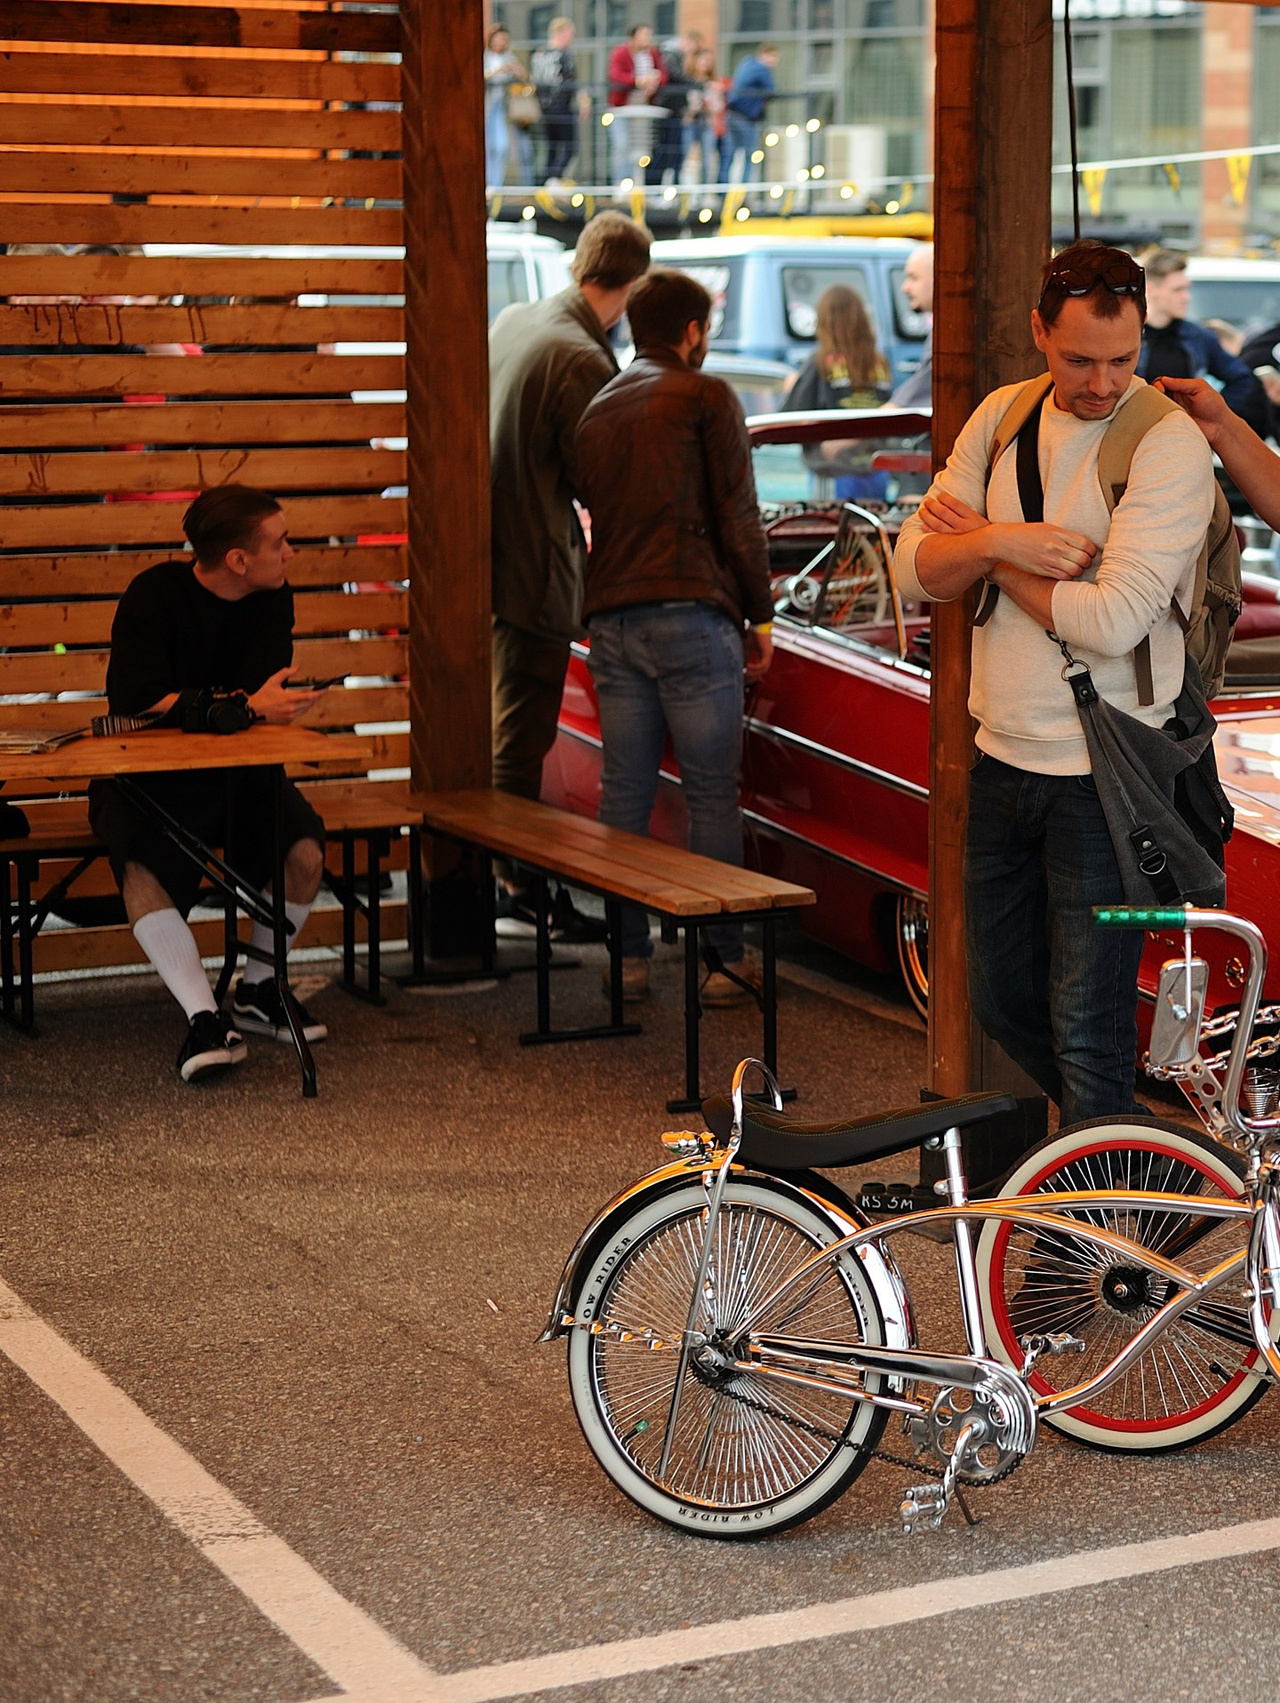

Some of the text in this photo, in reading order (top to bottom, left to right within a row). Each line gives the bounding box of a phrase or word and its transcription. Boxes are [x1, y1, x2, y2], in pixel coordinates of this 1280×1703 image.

[595, 1237, 632, 1285] RIDER
[679, 1506, 776, 1523] LOW RIDER
